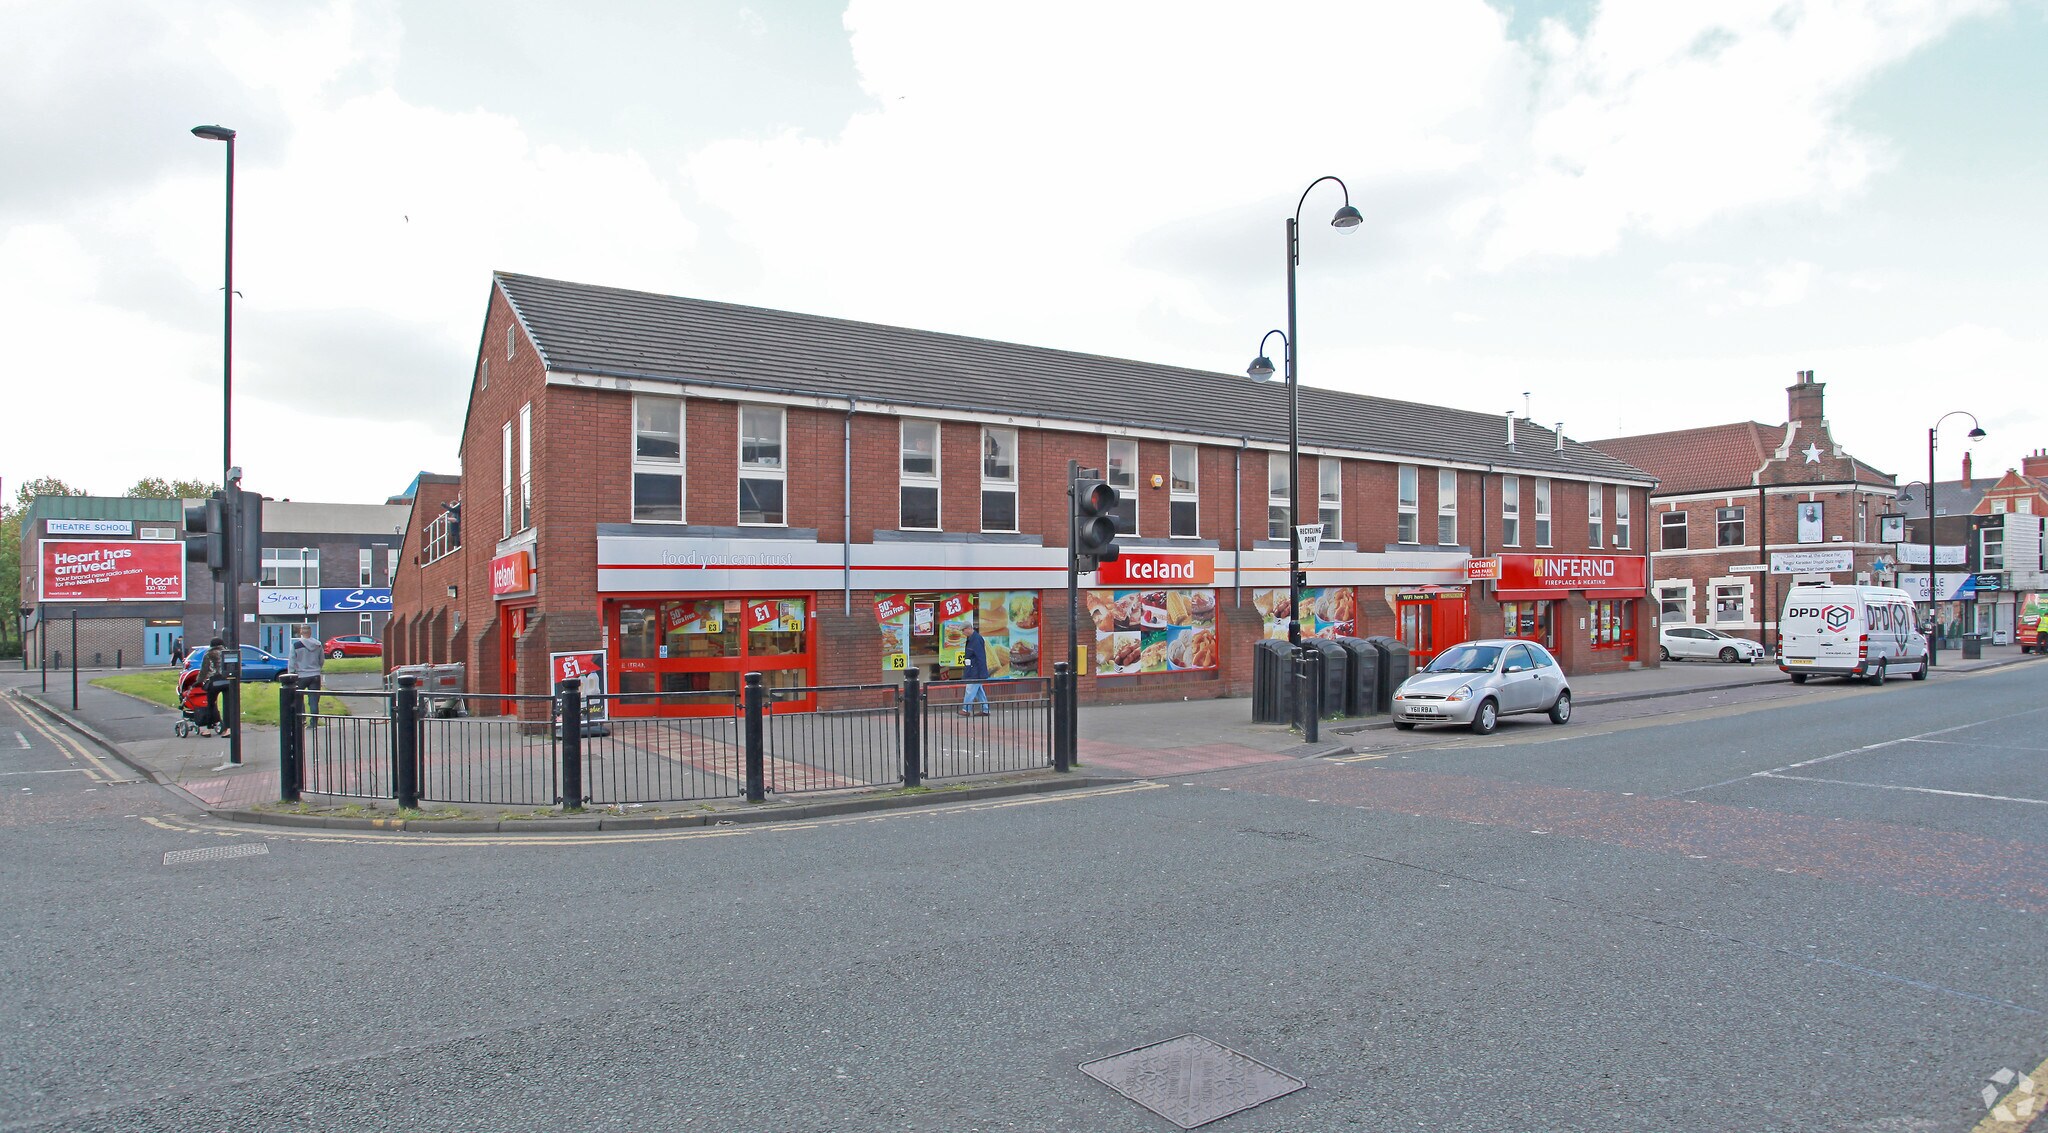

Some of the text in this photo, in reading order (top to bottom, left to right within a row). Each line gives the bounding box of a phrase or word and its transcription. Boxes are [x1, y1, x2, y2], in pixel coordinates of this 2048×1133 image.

[50, 523, 131, 532] THEATRE SCHOOL
[1299, 527, 1321, 535] RECYCLING
[54, 548, 132, 565] Heart has
[661, 549, 793, 570] food you can trust
[54, 559, 116, 575] arrived!
[1125, 559, 1194, 579] Iceland
[1468, 559, 1496, 569] Iceland
[1544, 558, 1614, 577] INFERNO
[145, 575, 179, 586] heart
[493, 560, 515, 589] Iceland
[1919, 577, 1944, 587] CYLE
[669, 606, 685, 620] 50%
[754, 604, 770, 622] £1
[878, 599, 893, 613] 50%
[880, 609, 893, 619] Extra
[892, 605, 904, 615] Free
[945, 597, 961, 616] £3
[1789, 607, 1820, 618] DPD
[672, 612, 696, 626] Extra Free
[1866, 604, 1890, 632] DPD
[708, 623, 717, 632] £3
[791, 622, 799, 631] £1
[562, 659, 581, 678] £1
[893, 658, 904, 668] £3
